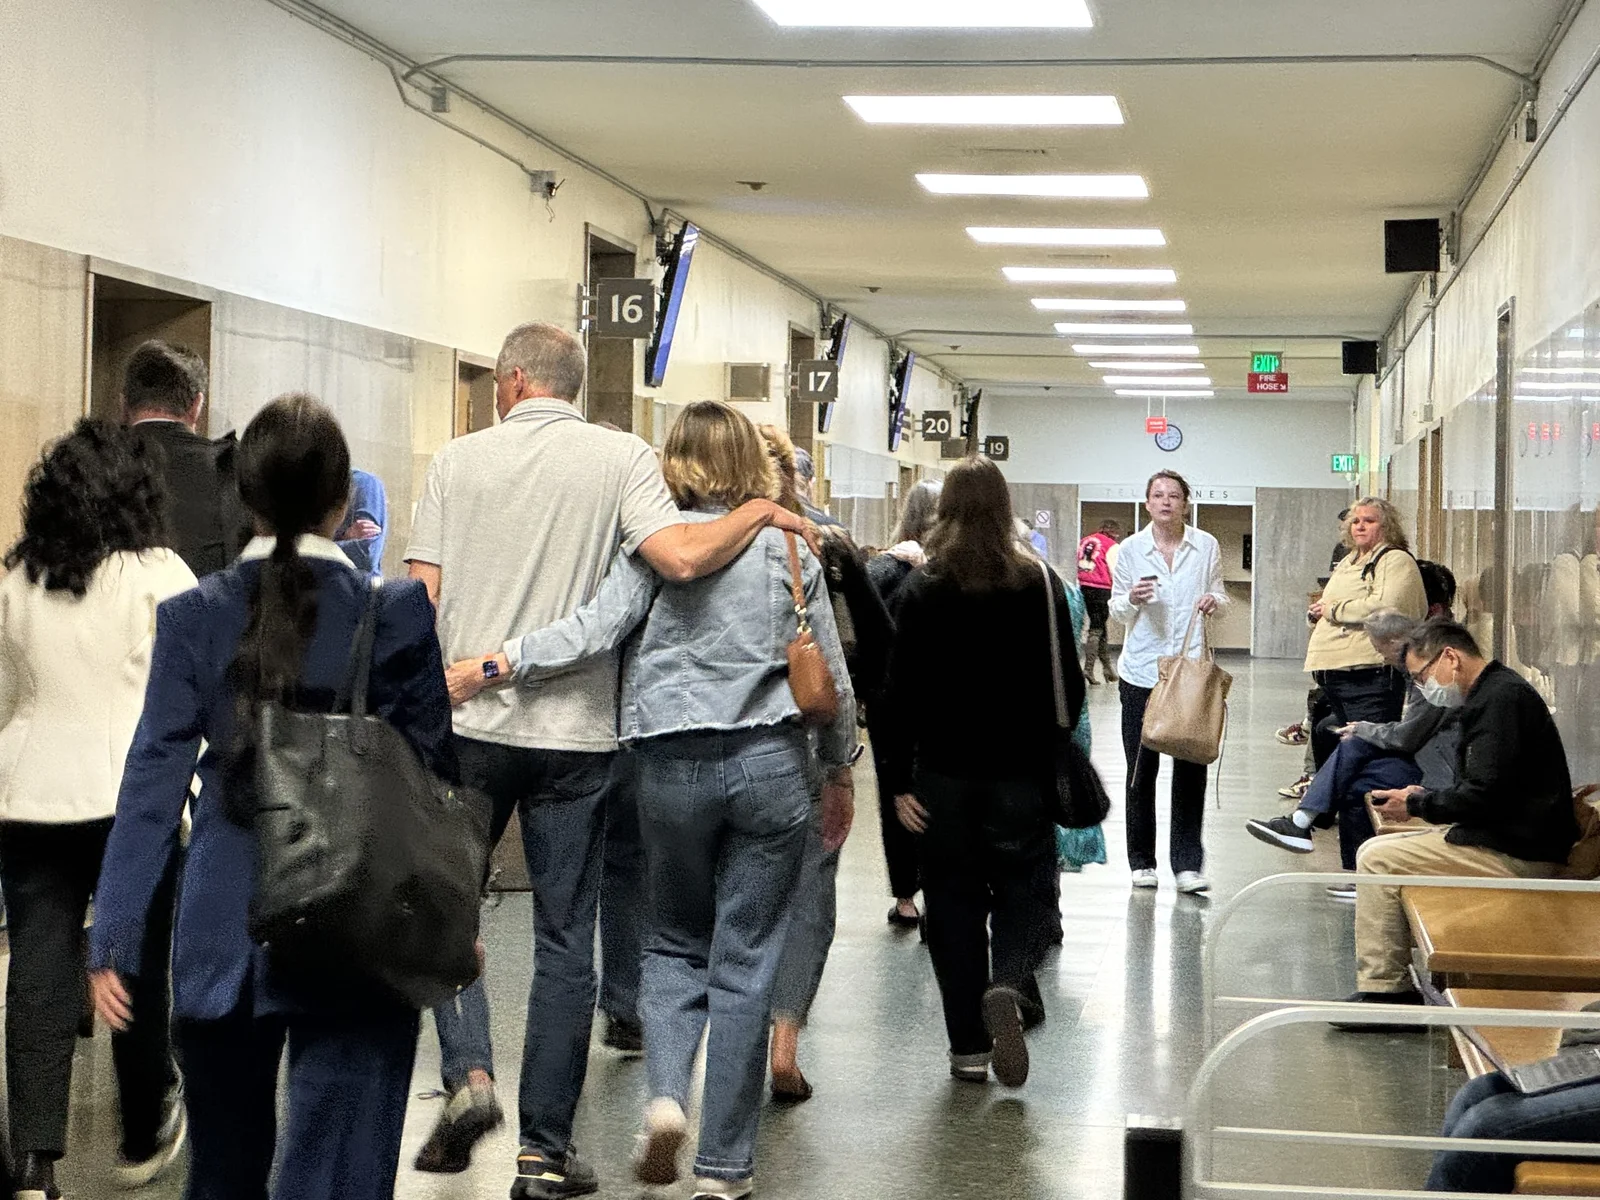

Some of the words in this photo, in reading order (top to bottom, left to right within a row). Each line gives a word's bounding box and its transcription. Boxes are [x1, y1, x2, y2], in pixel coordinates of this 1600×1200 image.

[611, 294, 643, 324] 16
[1253, 354, 1276, 373] EXIT
[808, 371, 832, 392] 17
[1259, 374, 1277, 382] FIRE
[1256, 383, 1279, 391] HOSE
[925, 418, 949, 434] 20
[989, 442, 1004, 455] 19
[1333, 455, 1353, 471] EXIT
[1105, 487, 1229, 499] TELNES
